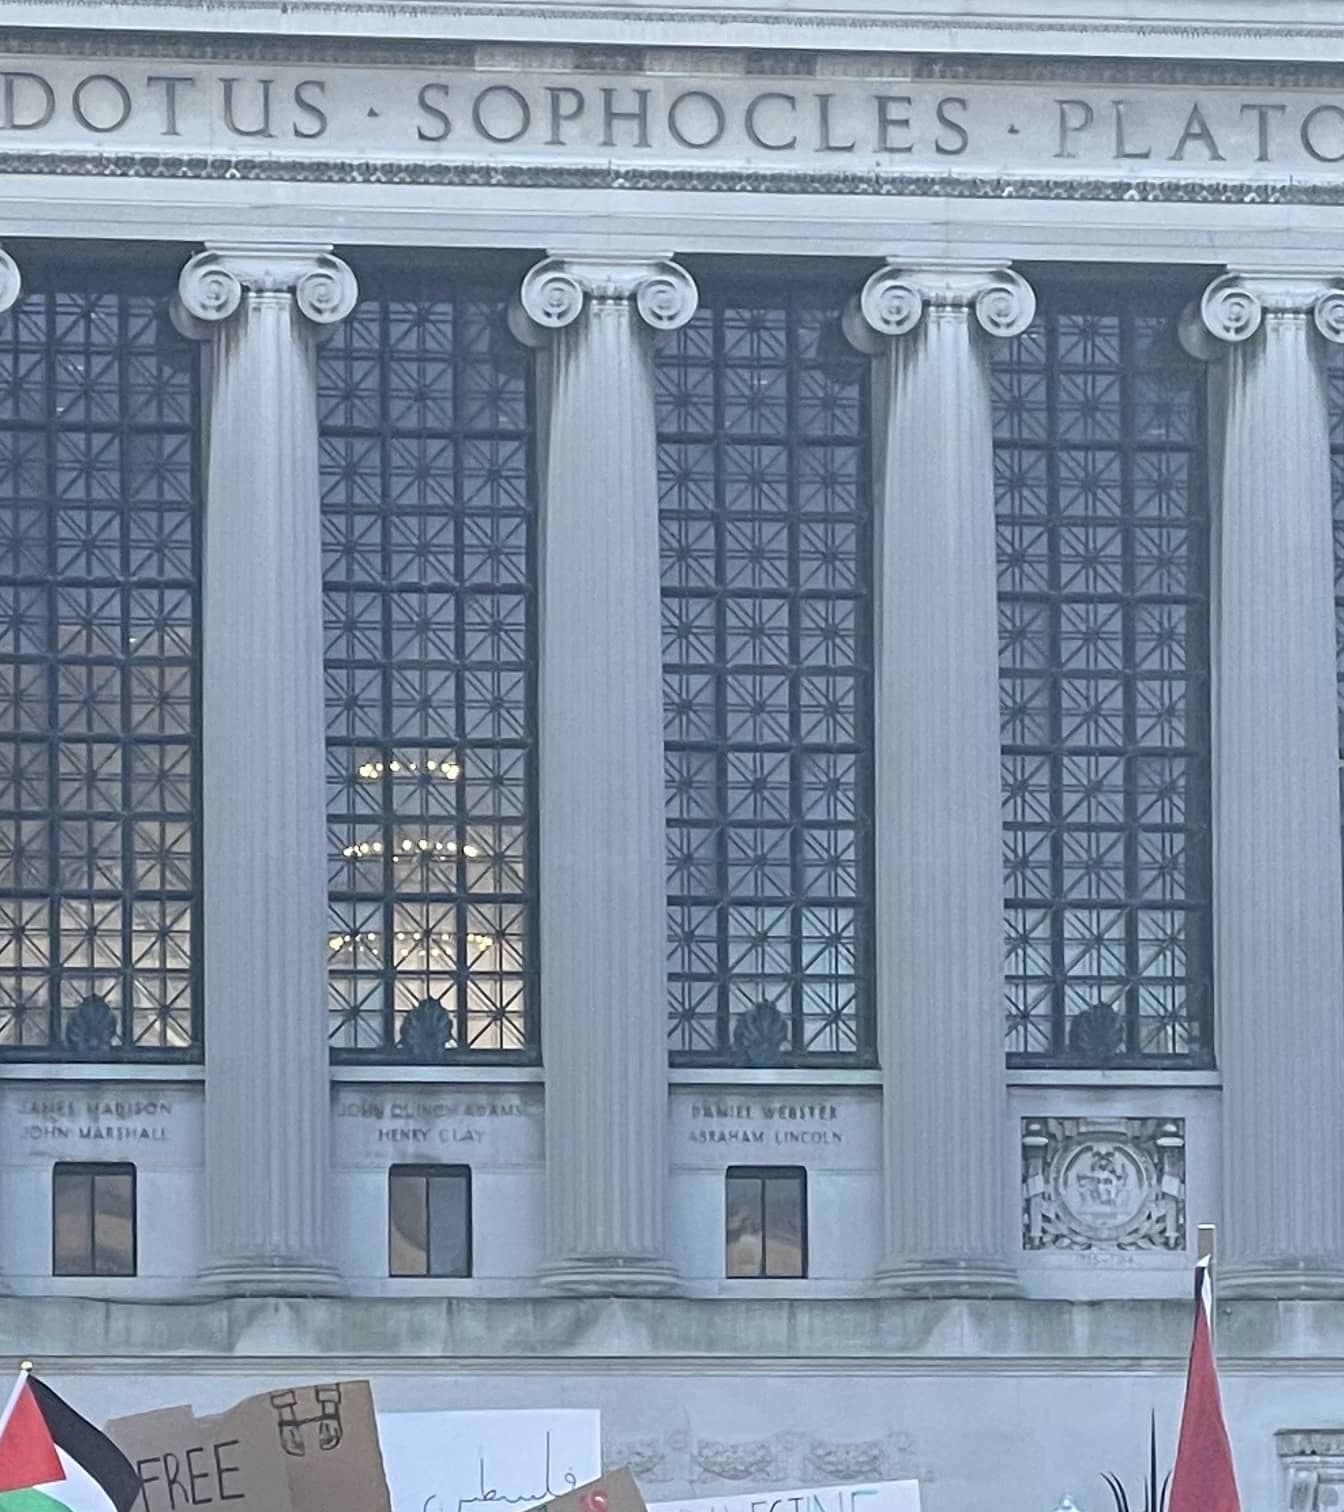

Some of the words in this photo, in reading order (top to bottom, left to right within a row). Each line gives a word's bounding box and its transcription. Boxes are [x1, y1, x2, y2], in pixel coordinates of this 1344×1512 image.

[414, 81, 974, 158] SOPHOCLES
[377, 1128, 432, 1143] HENRY
[438, 1128, 487, 1144] CLAY
[774, 1130, 843, 1146] LINCOLN
